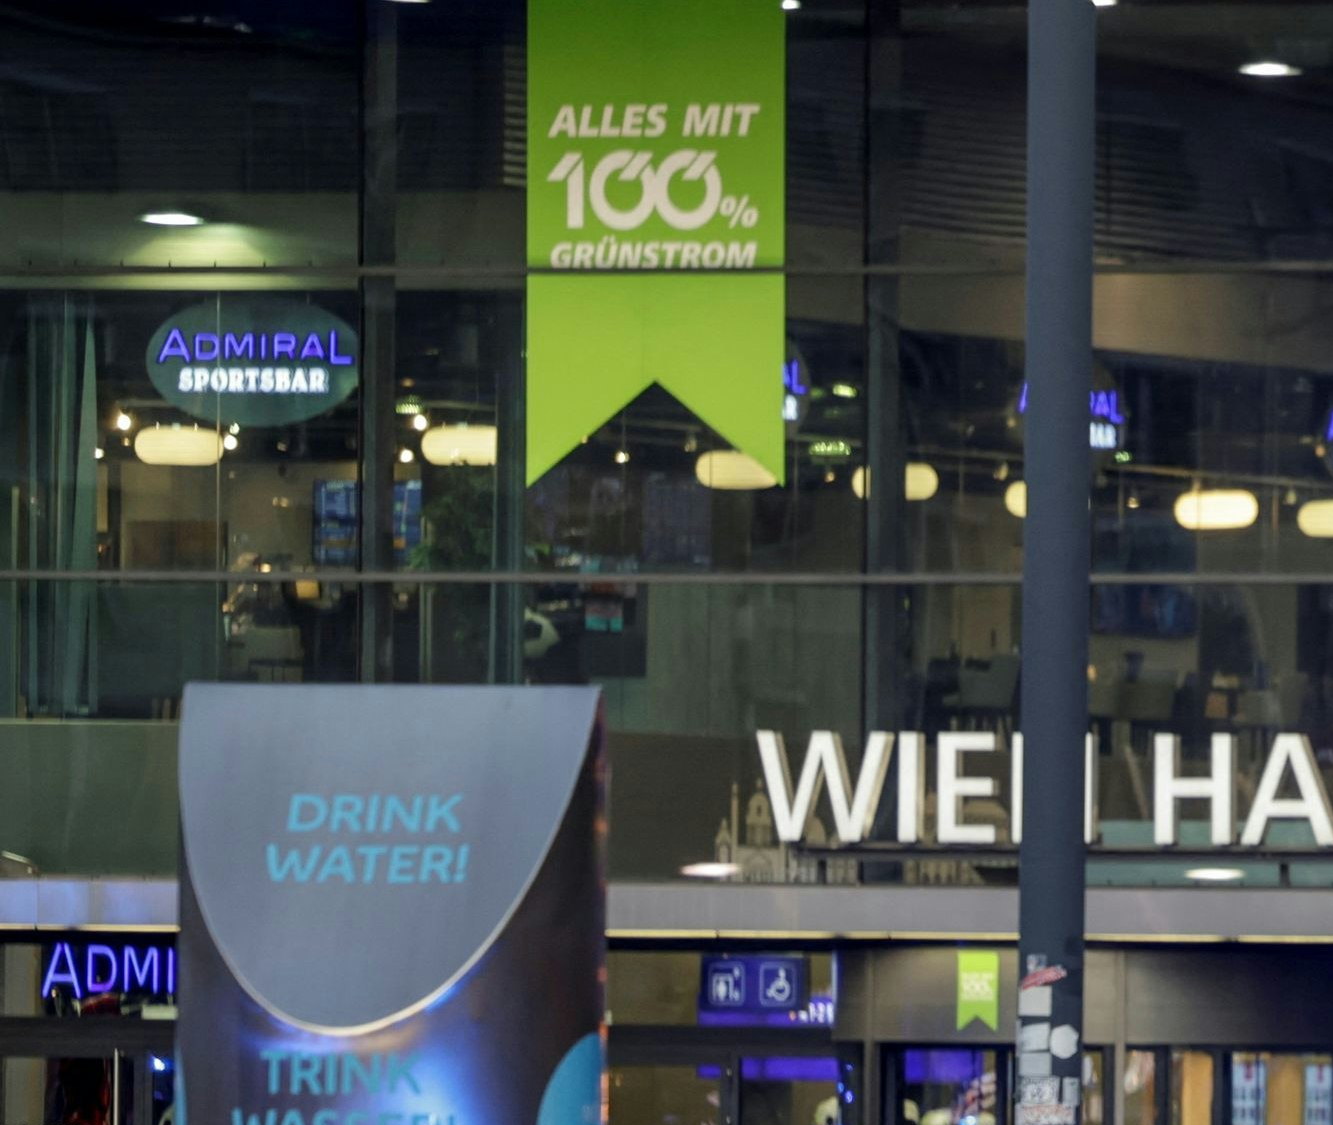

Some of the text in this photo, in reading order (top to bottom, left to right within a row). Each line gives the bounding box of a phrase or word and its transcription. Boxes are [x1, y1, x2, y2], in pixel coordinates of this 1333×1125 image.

[548, 102, 761, 138] ALLES MIT
[546, 149, 759, 232] 100%
[549, 234, 758, 269] GRÜNSTROM
[157, 328, 353, 364] ADMIRAL
[178, 366, 329, 393] SPORTSBAR
[755, 730, 1096, 845] WIE
[286, 793, 464, 833] DRINK
[265, 843, 472, 885] WATER!
[41, 942, 176, 999] ADMI
[260, 1050, 423, 1096] TRINK
